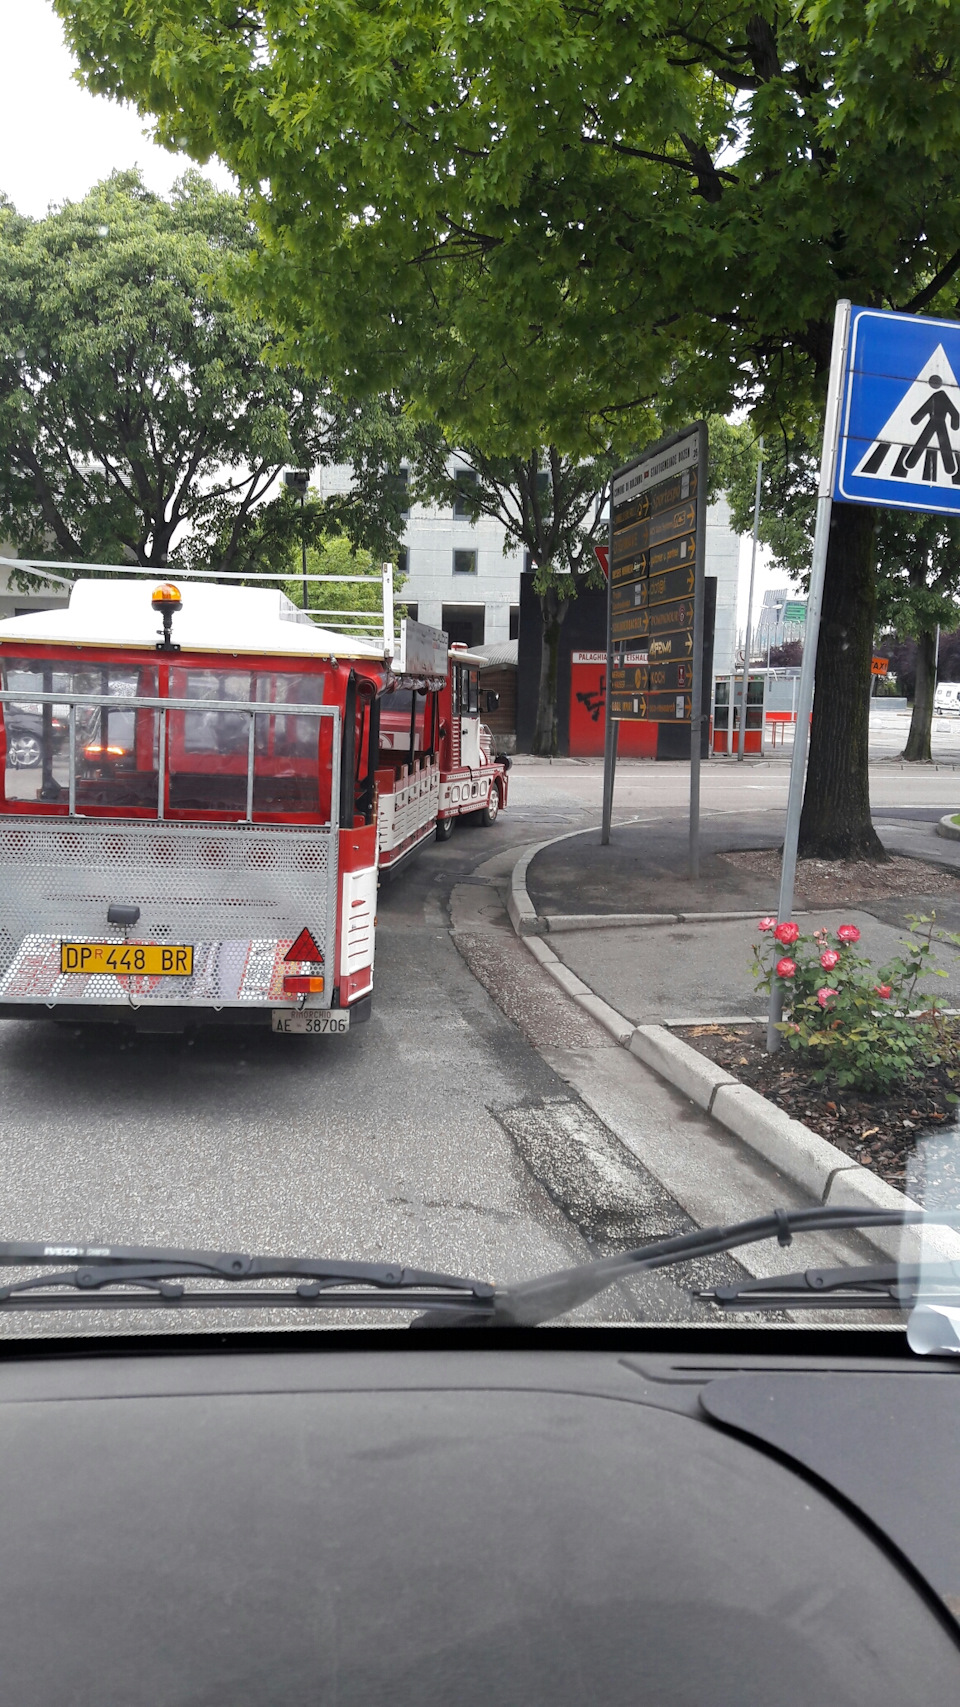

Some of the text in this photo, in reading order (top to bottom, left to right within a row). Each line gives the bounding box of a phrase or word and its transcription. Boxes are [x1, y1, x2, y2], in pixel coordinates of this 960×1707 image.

[678, 447, 690, 462] BOZEN
[630, 474, 643, 489] BOLZANO
[106, 948, 146, 971] 448
[161, 949, 188, 971] BR
[291, 1010, 332, 1019] RIMORCHIO
[276, 1018, 346, 1033] AE 38706
